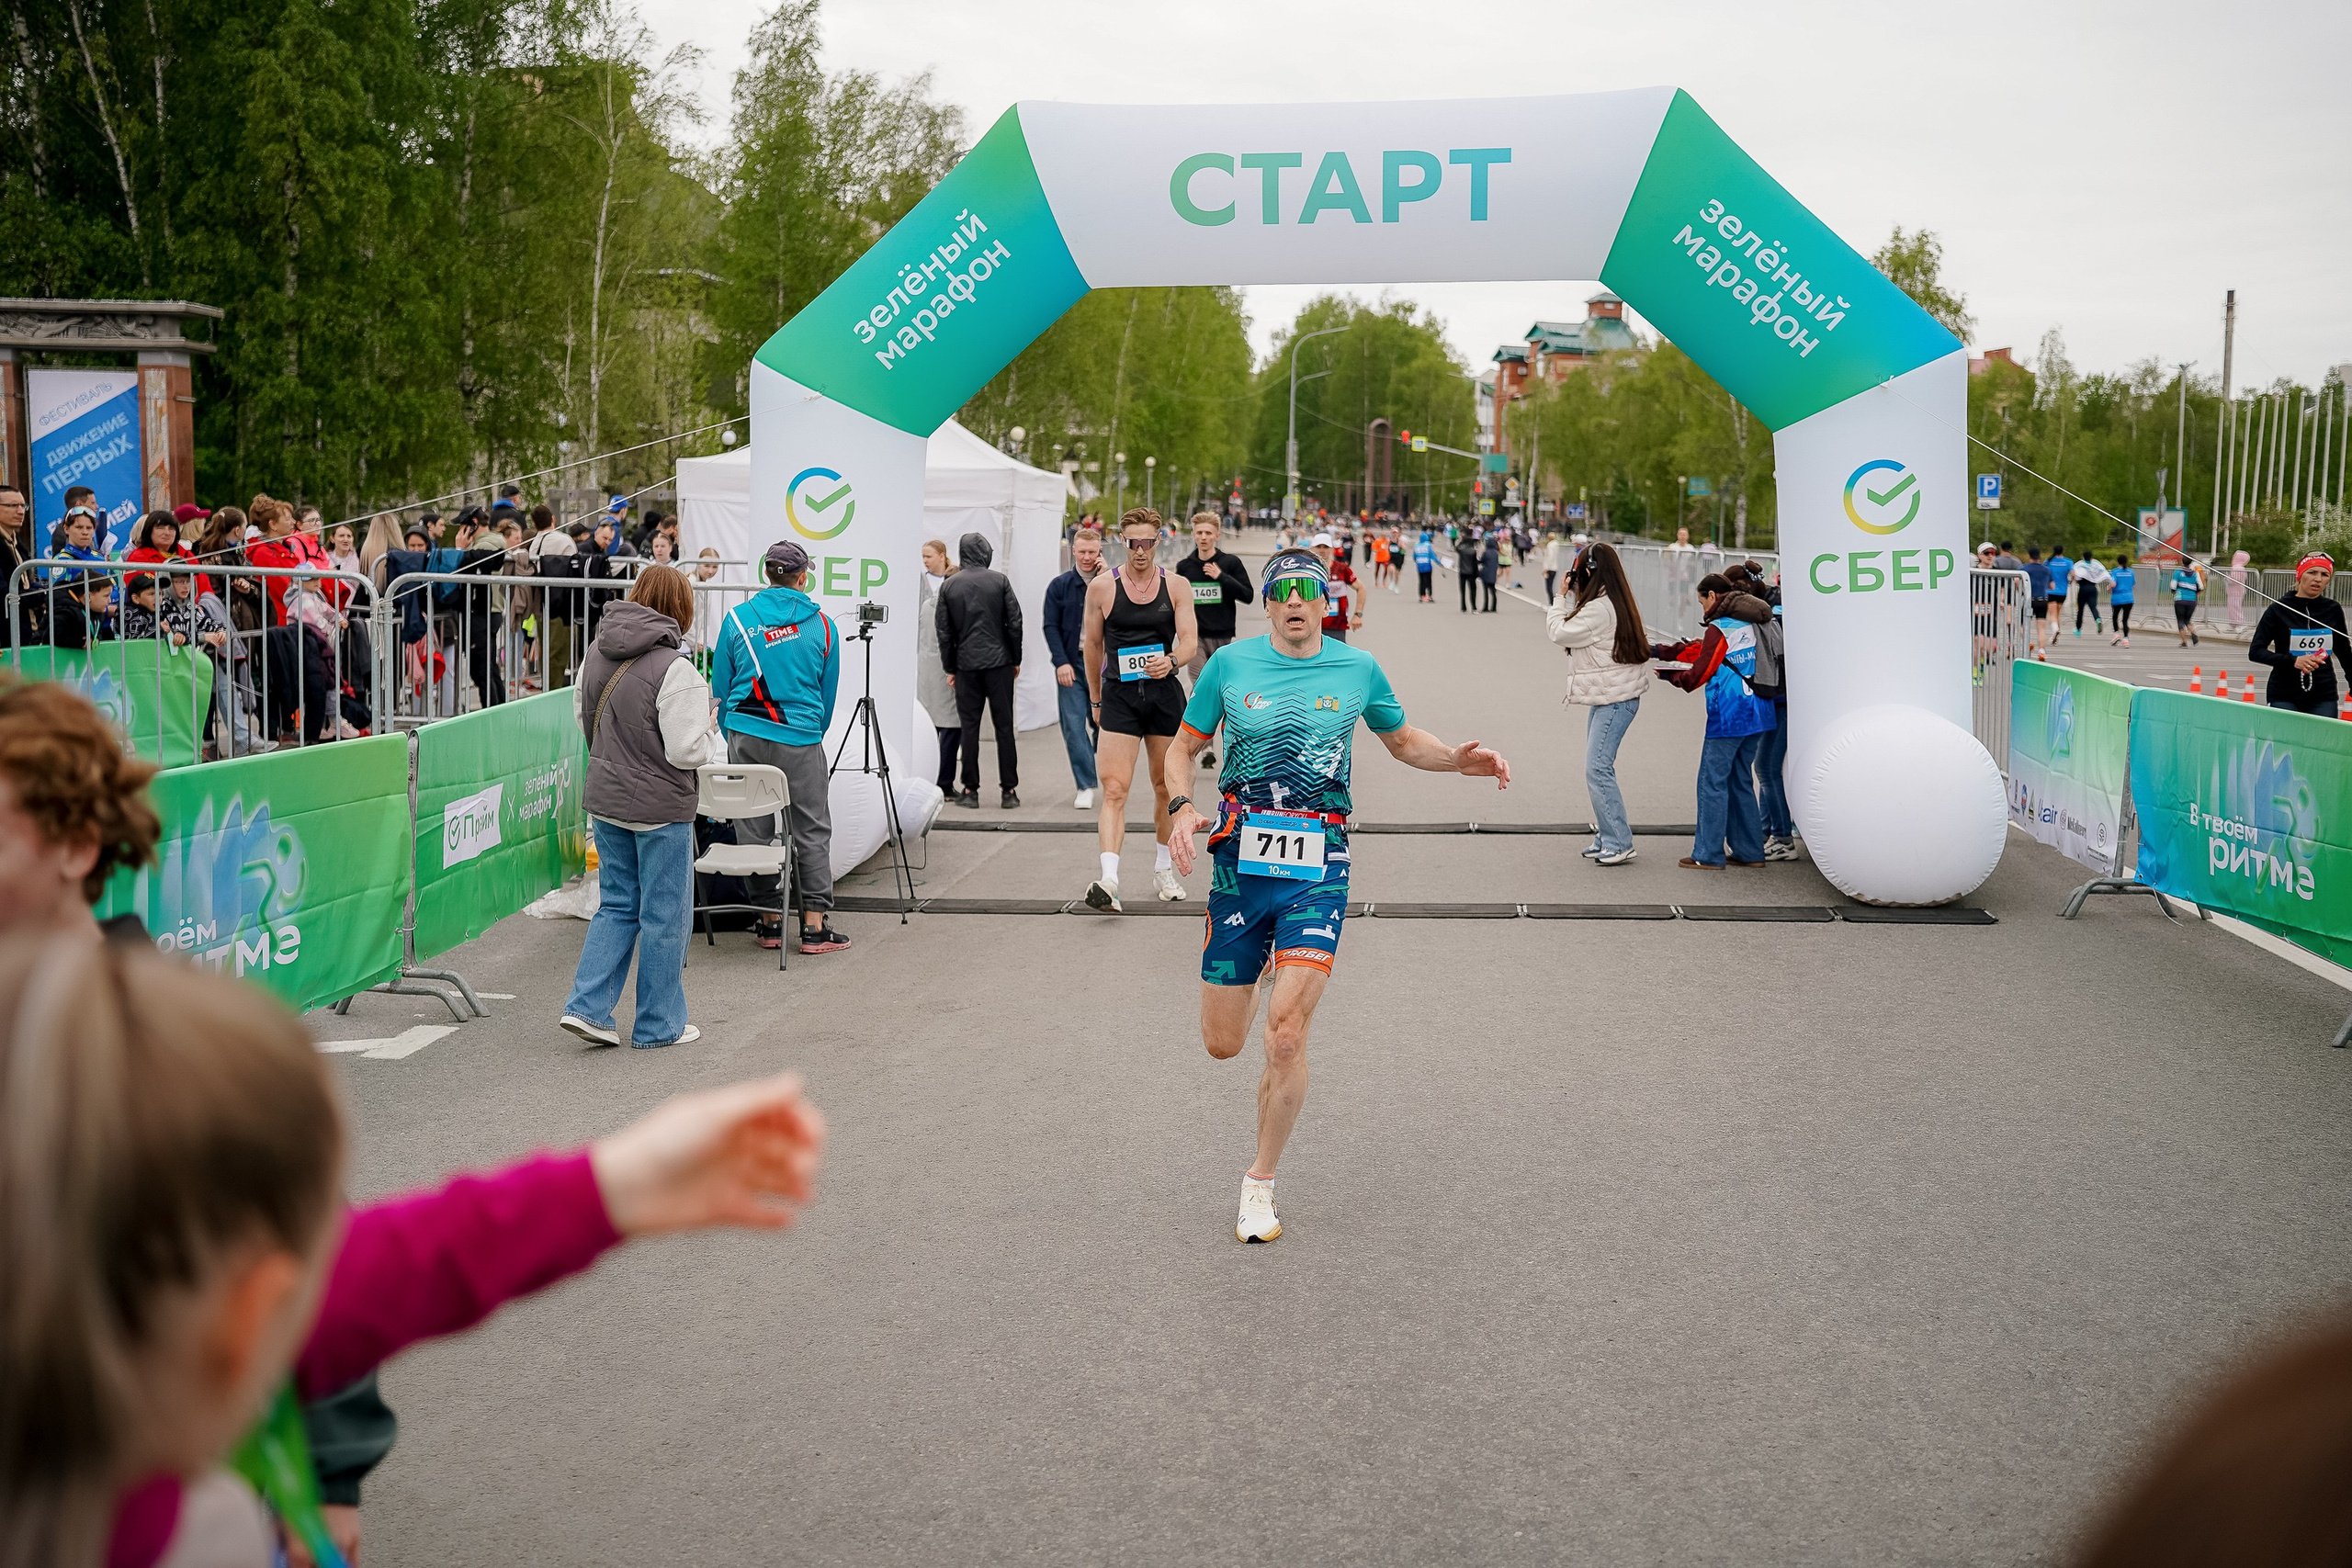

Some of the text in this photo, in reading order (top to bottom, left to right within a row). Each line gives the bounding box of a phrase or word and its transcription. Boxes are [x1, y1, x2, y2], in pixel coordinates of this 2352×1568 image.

[1169, 147, 1512, 227] СТАРТ
[852, 208, 988, 344] зелёный
[1671, 223, 1820, 358] марафон
[1699, 197, 1851, 332] зелёный
[874, 239, 1012, 371] марафон
[39, 381, 113, 426] ФЕСТИВАЛЬ
[41, 432, 135, 495] ПЕРВЫХ
[45, 411, 130, 469] ДВИЖЕНИЕ
[1194, 588, 1217, 598] 1405
[1809, 548, 1954, 594] СБЕР
[768, 626, 795, 640] TIME
[2299, 637, 2325, 649] 669
[1128, 654, 1156, 670] 80
[1257, 832, 1305, 861] 711
[2189, 802, 2259, 845] В твоём
[2209, 836, 2316, 901] ритме
